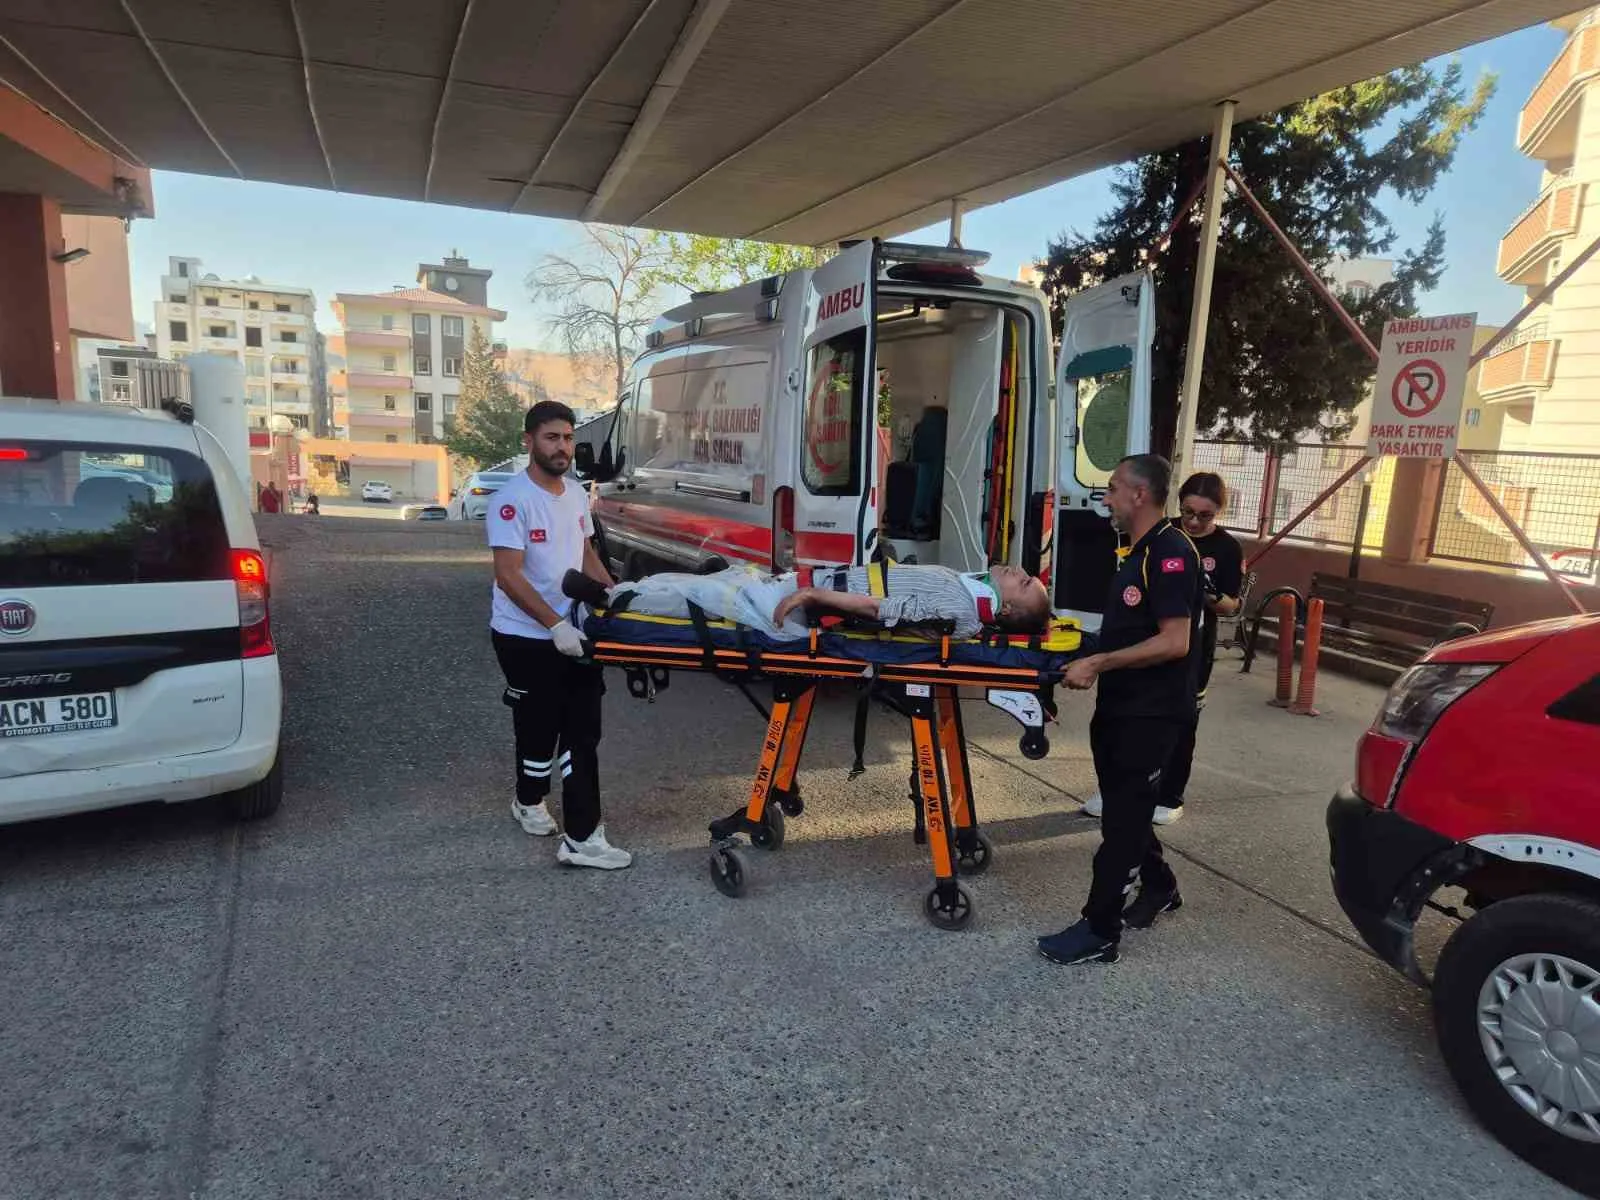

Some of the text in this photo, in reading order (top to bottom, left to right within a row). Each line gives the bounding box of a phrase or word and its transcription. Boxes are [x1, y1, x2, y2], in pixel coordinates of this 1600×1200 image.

[817, 282, 865, 321] AMBU
[1387, 315, 1472, 335] AMBULANS
[1395, 336, 1456, 355] YERİDİR
[1370, 424, 1456, 440] PARK ETMEK
[1377, 442, 1444, 457] YASAKTIR
[2, 609, 26, 625] FIAT
[0, 700, 47, 728] ACN
[60, 695, 107, 721] 580
[758, 763, 771, 782] TAY
[928, 796, 941, 814] TAY
